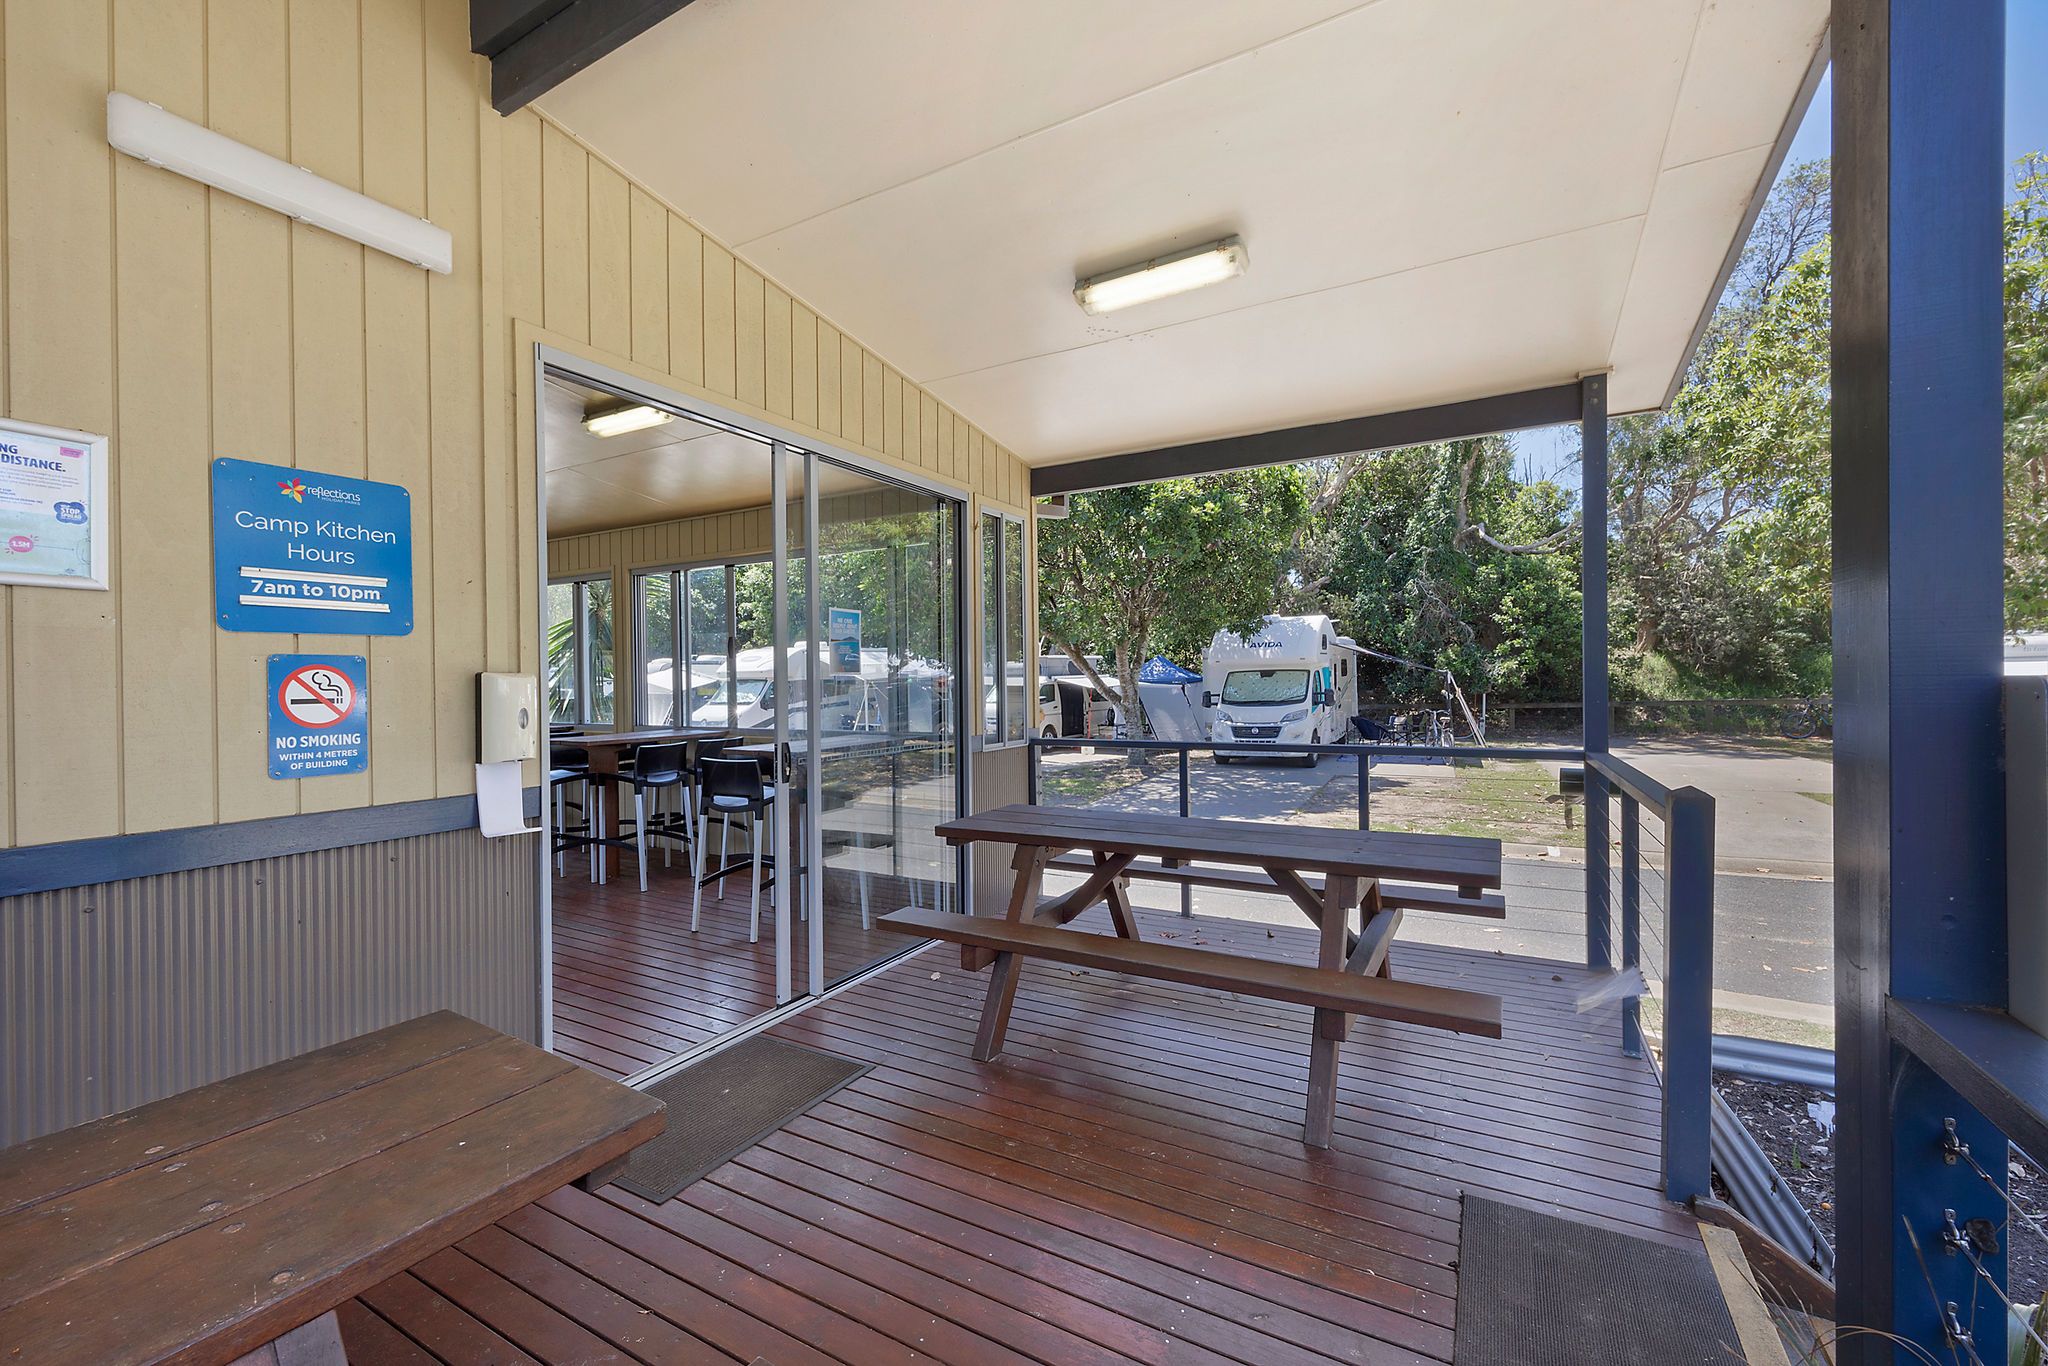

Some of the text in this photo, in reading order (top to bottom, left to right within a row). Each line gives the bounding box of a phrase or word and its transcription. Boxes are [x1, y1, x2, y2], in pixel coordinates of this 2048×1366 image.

[1, 453, 66, 472] DISTANCE.
[307, 486, 361, 502] reflections
[60, 507, 80, 515] STOP
[235, 510, 397, 545] Camp Kitchen
[287, 542, 356, 565] Hours
[251, 579, 381, 601] 7am to 10pm
[276, 733, 361, 750] NO SMOKING
[279, 749, 358, 761] WITHIN 4 METRES
[290, 759, 348, 770] OF BUILDING
